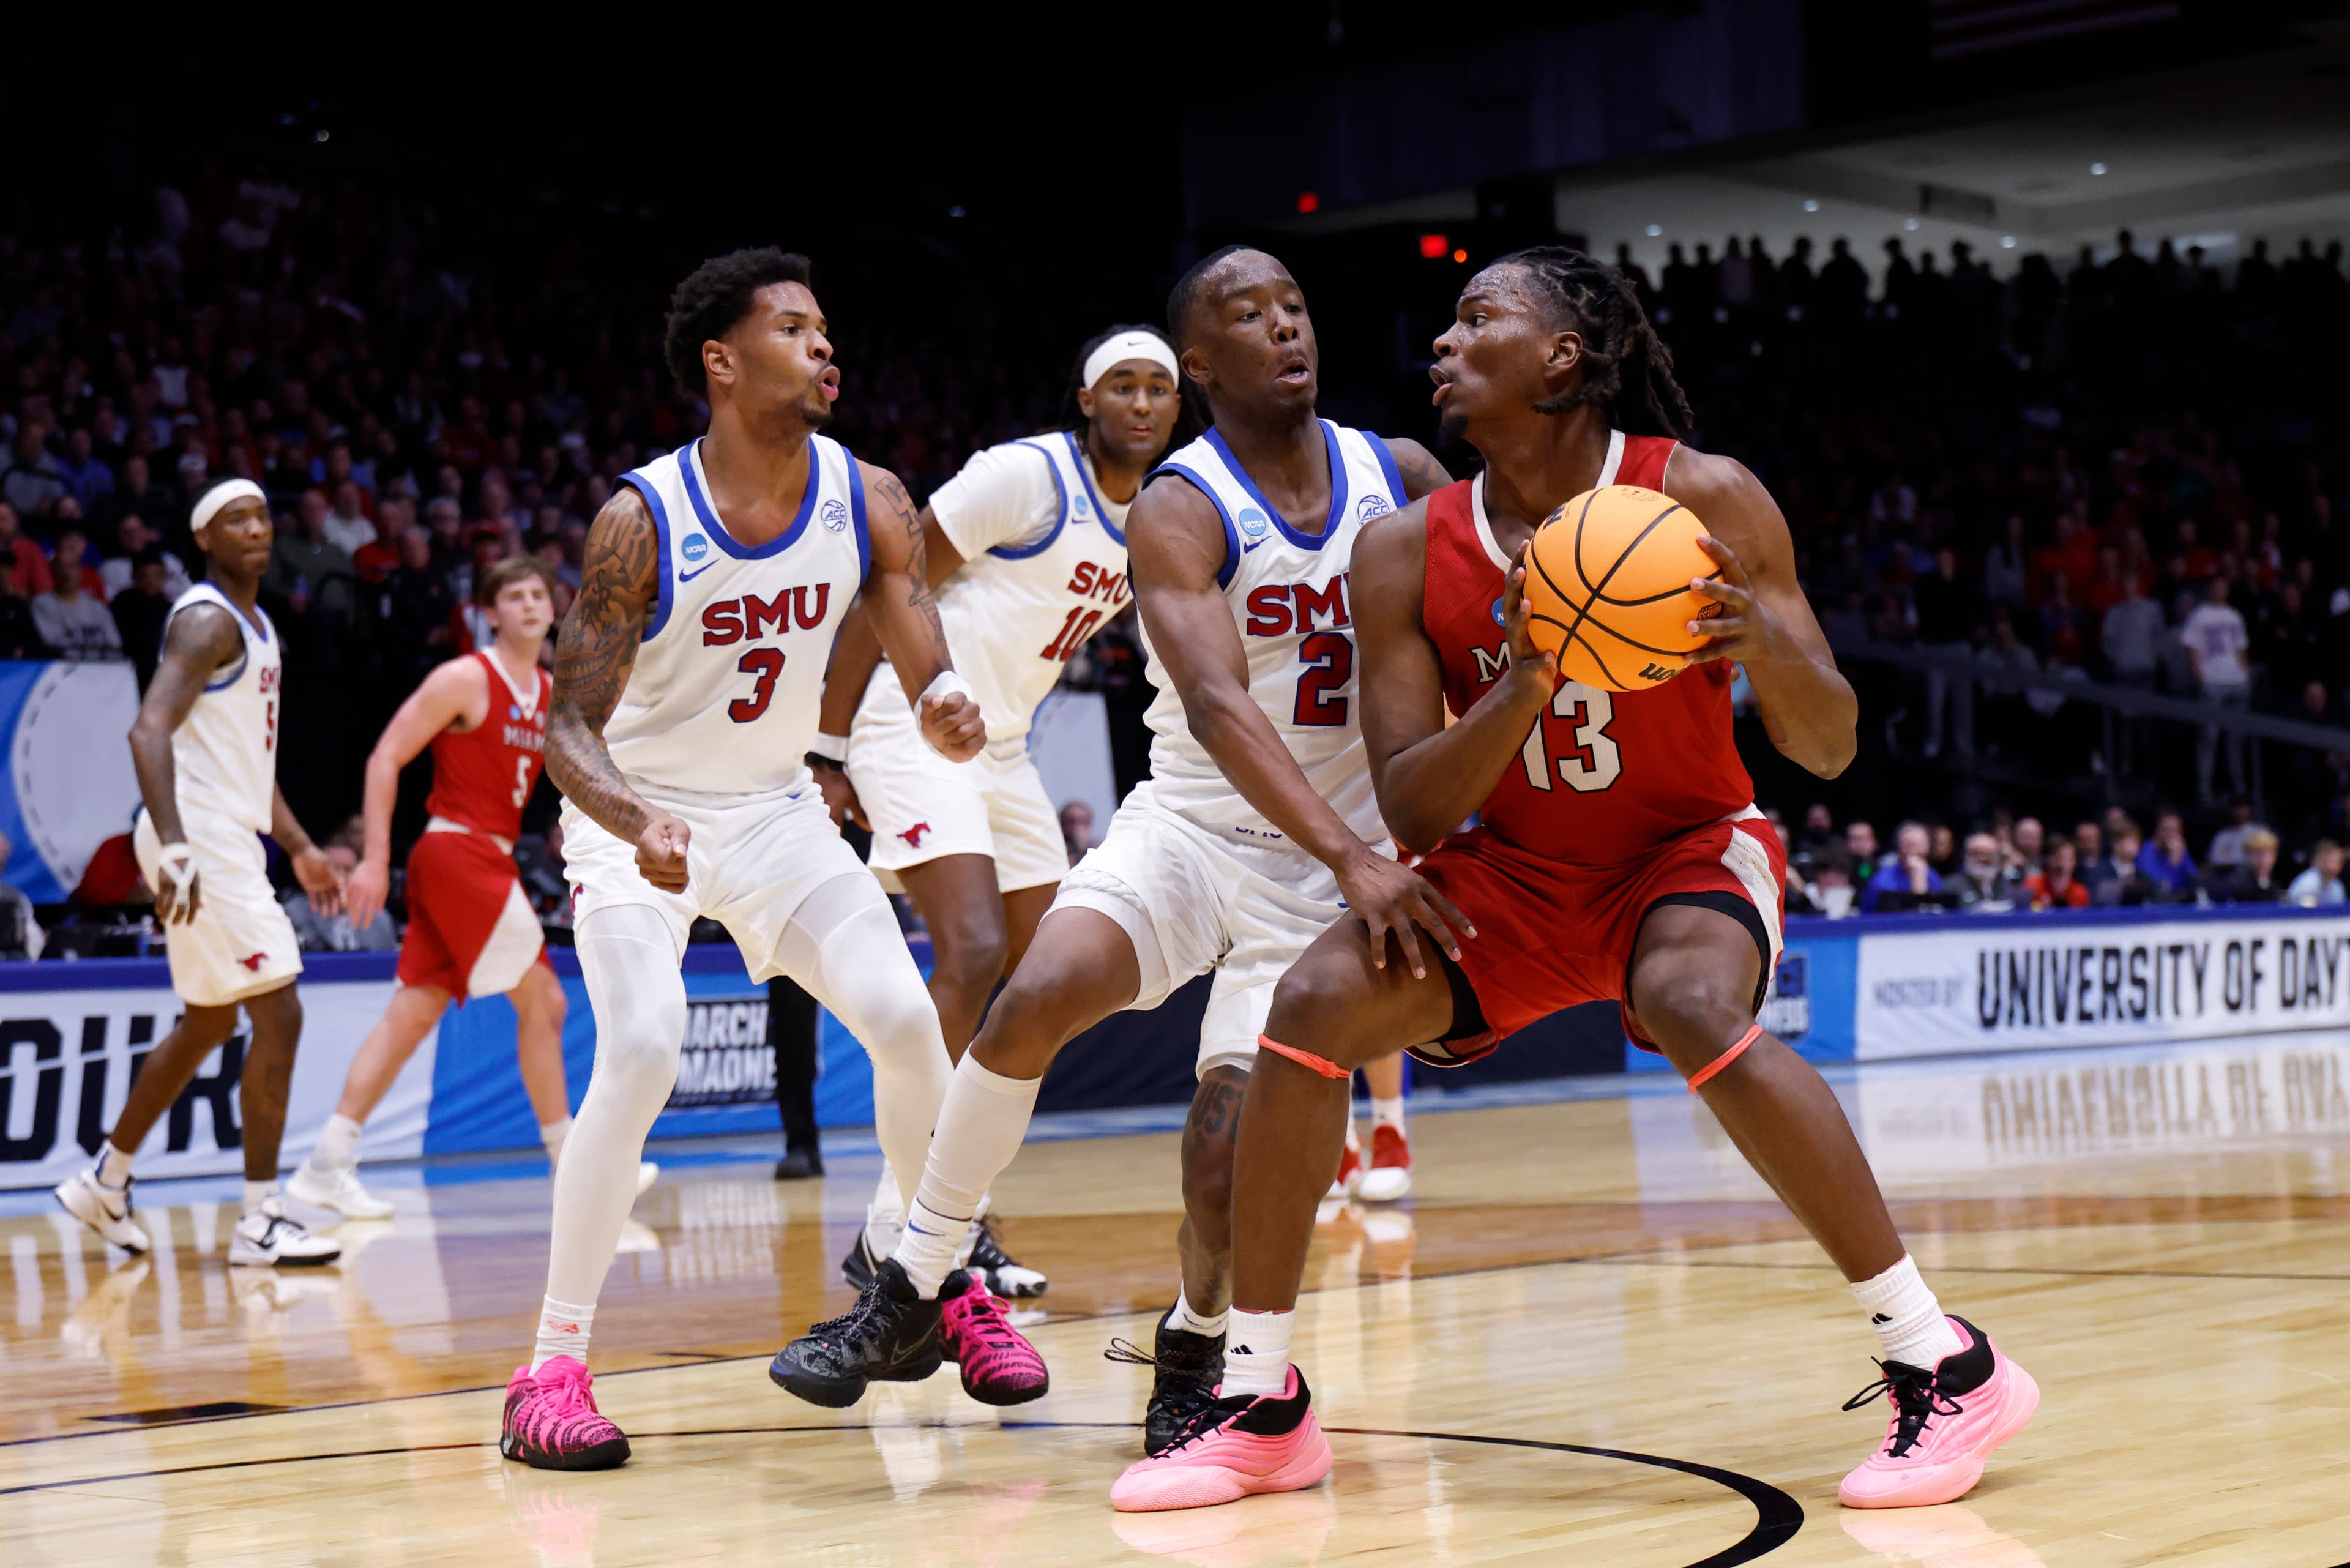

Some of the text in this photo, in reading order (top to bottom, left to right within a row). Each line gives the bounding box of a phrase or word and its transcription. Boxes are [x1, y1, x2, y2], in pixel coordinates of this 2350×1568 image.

[825, 509, 846, 520] ACC
[1363, 505, 1388, 517] ACC
[685, 544, 706, 554] NCAA
[1067, 561, 1130, 605] SMU
[1246, 572, 1351, 637] SM
[702, 583, 830, 646] SMU
[1040, 606, 1103, 662] 10
[728, 647, 786, 723] 3
[1293, 632, 1353, 726] 2
[1522, 678, 1624, 793] 13
[512, 755, 532, 808] 5
[1979, 939, 2210, 1028] UNIVERSITY
[2224, 939, 2264, 1011] OF
